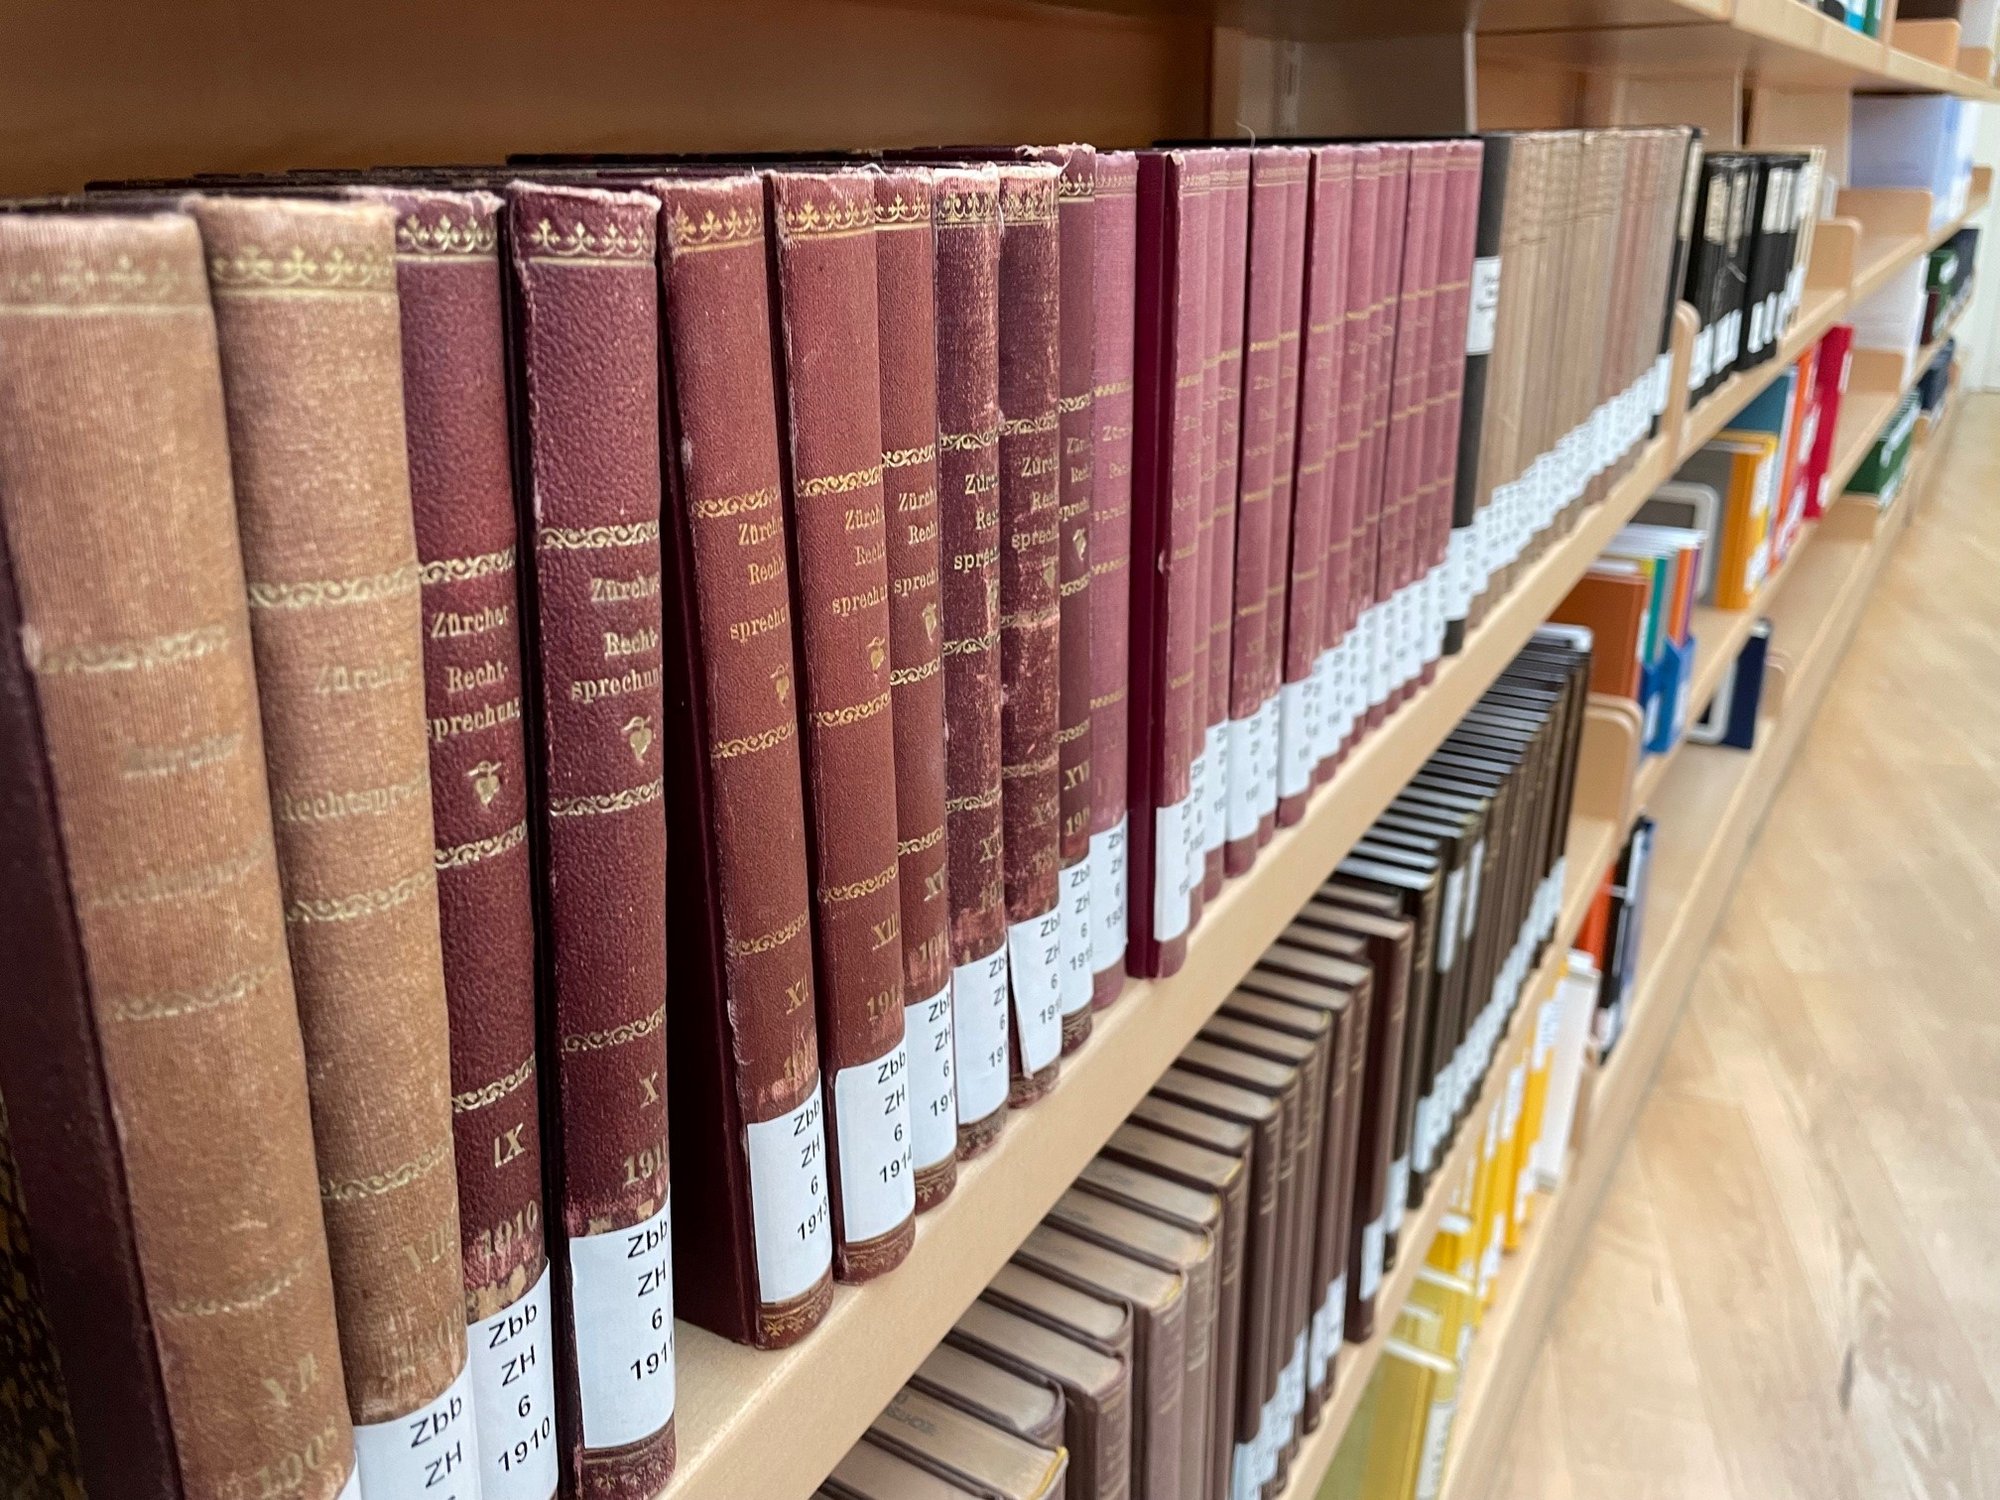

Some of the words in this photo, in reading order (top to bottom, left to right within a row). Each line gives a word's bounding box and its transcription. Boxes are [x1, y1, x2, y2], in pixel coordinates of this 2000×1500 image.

[877, 1051, 906, 1085] Zbb
[942, 1059, 950, 1078] 6
[639, 1072, 661, 1109] X
[884, 1083, 905, 1116] ZH
[793, 1099, 820, 1137] Zbb
[893, 1122, 903, 1142] 6
[494, 1122, 526, 1169] IX
[801, 1132, 820, 1169] ZH
[810, 1174, 819, 1196] 6
[627, 1219, 667, 1259] Zbb
[637, 1260, 666, 1298] ZH
[488, 1303, 537, 1349] Zbb
[651, 1307, 663, 1331] 6
[501, 1343, 536, 1387] ZH
[410, 1396, 462, 1449] Zbb
[518, 1394, 531, 1418] 6
[498, 1416, 550, 1472] 1910
[424, 1440, 462, 1489] ZH
